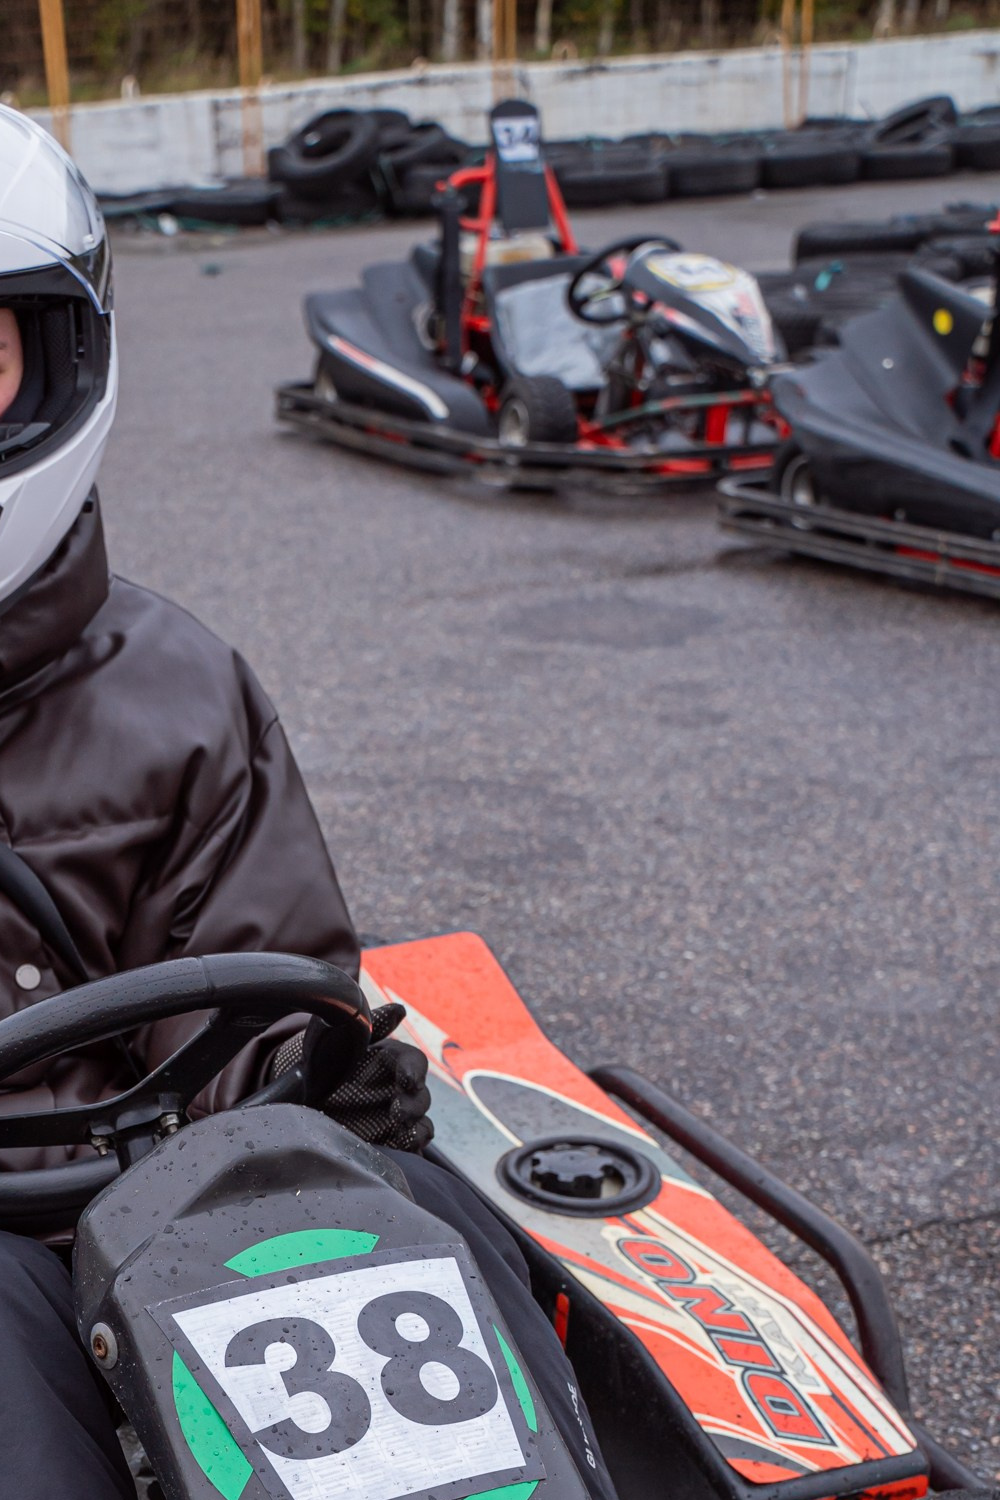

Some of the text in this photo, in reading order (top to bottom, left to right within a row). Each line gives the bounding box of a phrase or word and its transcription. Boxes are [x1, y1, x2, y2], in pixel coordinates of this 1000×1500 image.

[224, 1289, 499, 1460] 38
[616, 1237, 839, 1447] DINO
[711, 1277, 821, 1388] KART
